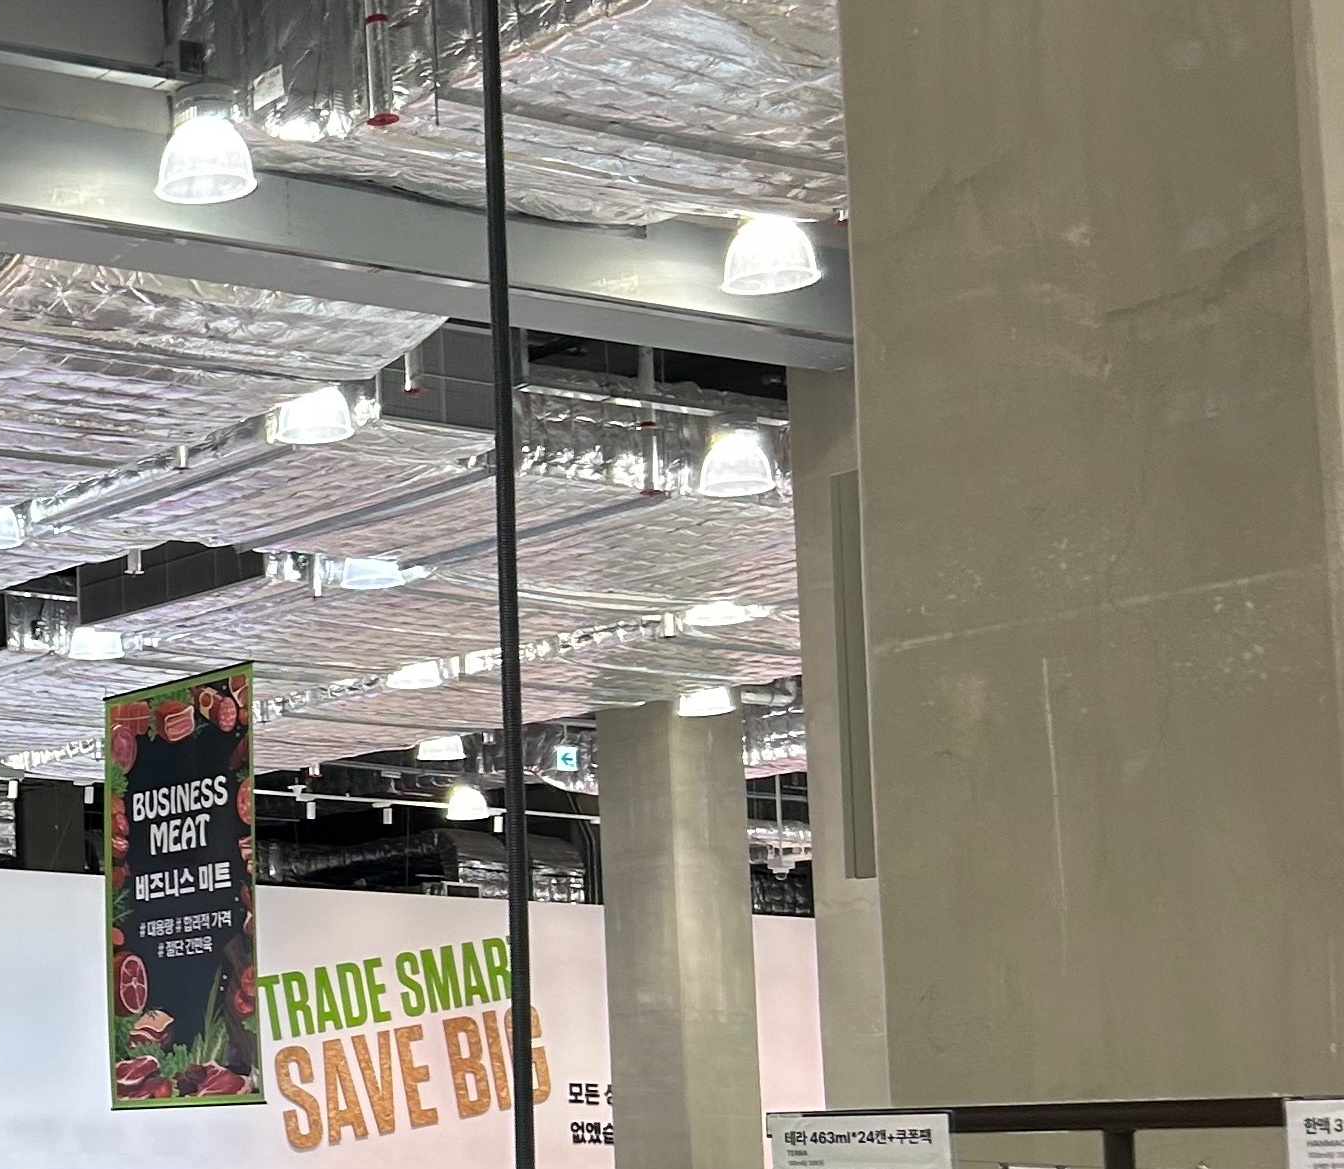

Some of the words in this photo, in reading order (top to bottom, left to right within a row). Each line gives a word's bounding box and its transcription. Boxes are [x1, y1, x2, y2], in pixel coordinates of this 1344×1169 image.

[132, 775, 228, 822] BUSINESS
[149, 813, 210, 856] MEAT
[135, 867, 195, 902] 비즈니스
[198, 861, 232, 892] 미트
[258, 957, 392, 1041] TRADE
[395, 937, 512, 1018] SMAR
[274, 1024, 439, 1153] SAVE
[443, 1004, 552, 1120] BIG
[568, 1082, 601, 1106] 모든
[784, 1130, 808, 1146] 테라
